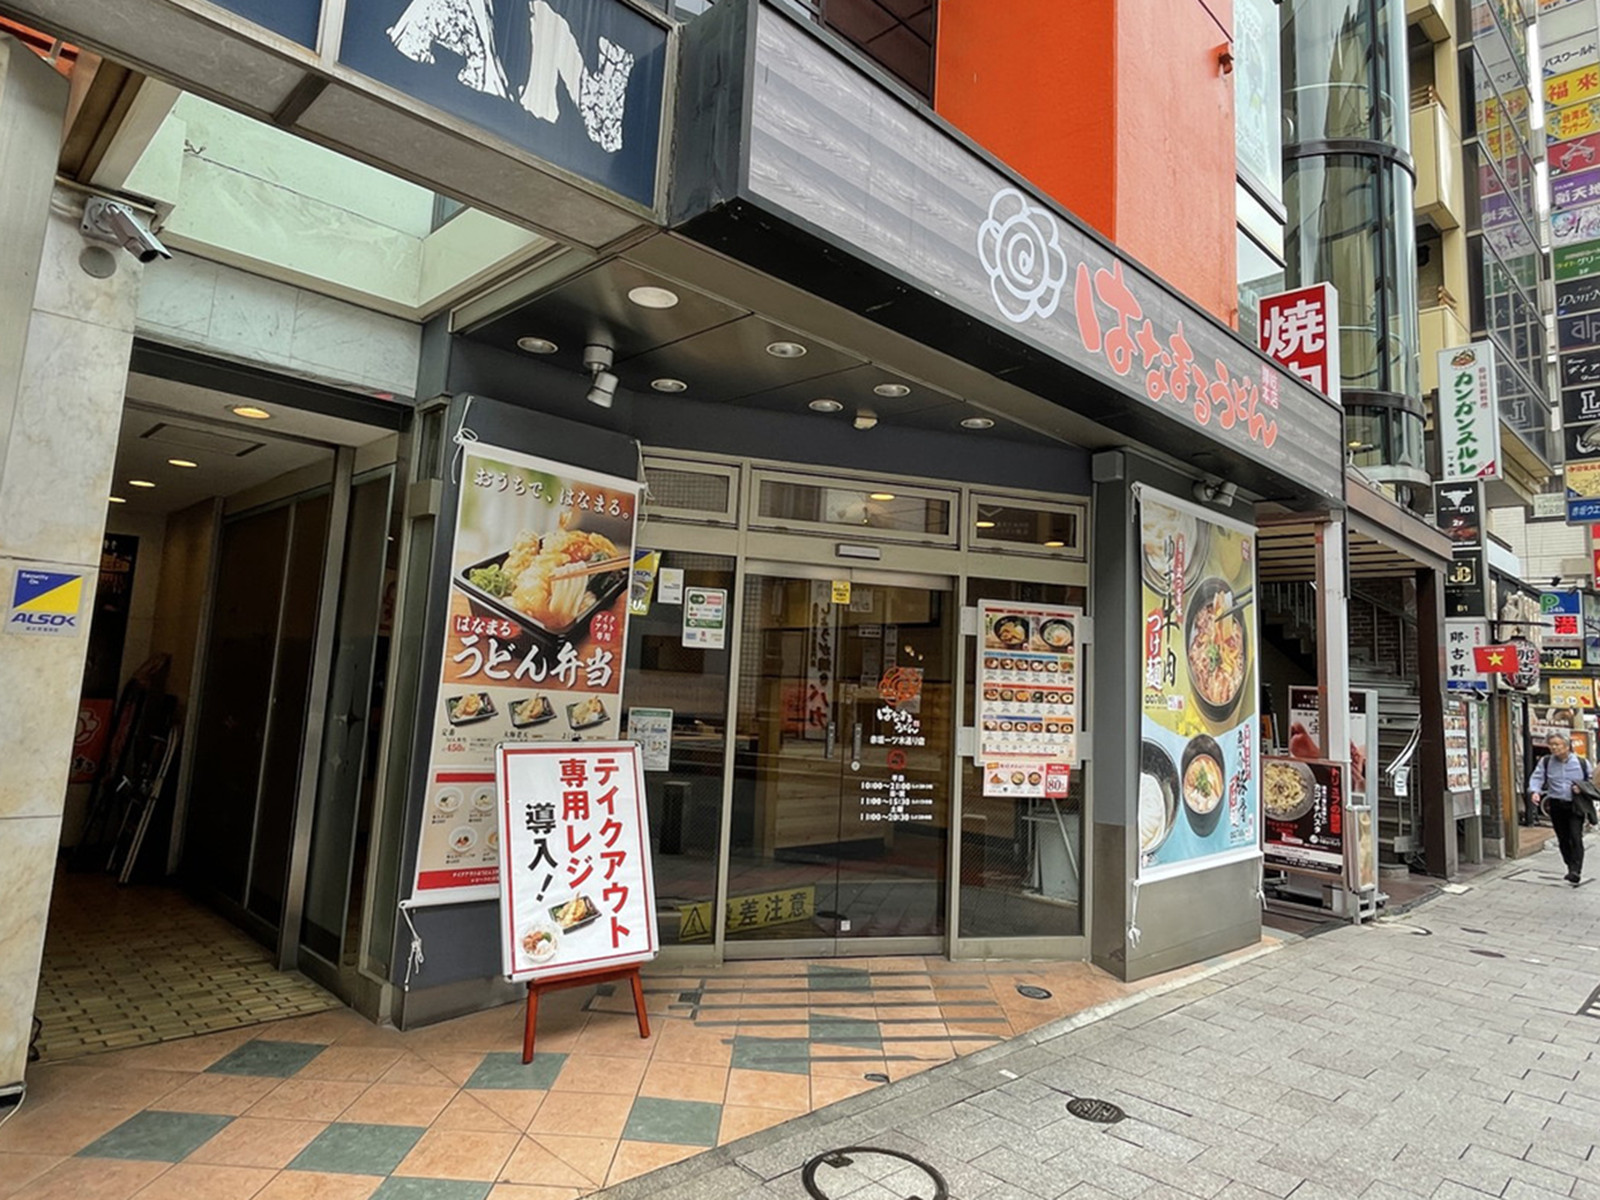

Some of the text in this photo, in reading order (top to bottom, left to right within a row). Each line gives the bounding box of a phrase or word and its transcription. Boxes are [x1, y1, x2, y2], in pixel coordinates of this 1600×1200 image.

[1074, 257, 1278, 448] はなまるうどん
[1454, 371, 1479, 475] カンガンスルレ
[1460, 505, 1475, 513] 101
[21, 572, 49, 580] Security
[11, 612, 76, 627] ALSOK
[456, 616, 512, 637] はなまる
[453, 635, 613, 688] うどん弁当
[1146, 614, 1163, 691] つけ麺
[1449, 631, 1465, 677] 那古野
[525, 802, 559, 902] 導入！
[559, 758, 594, 889] 専用レジ
[594, 758, 630, 948] テイクアウト
